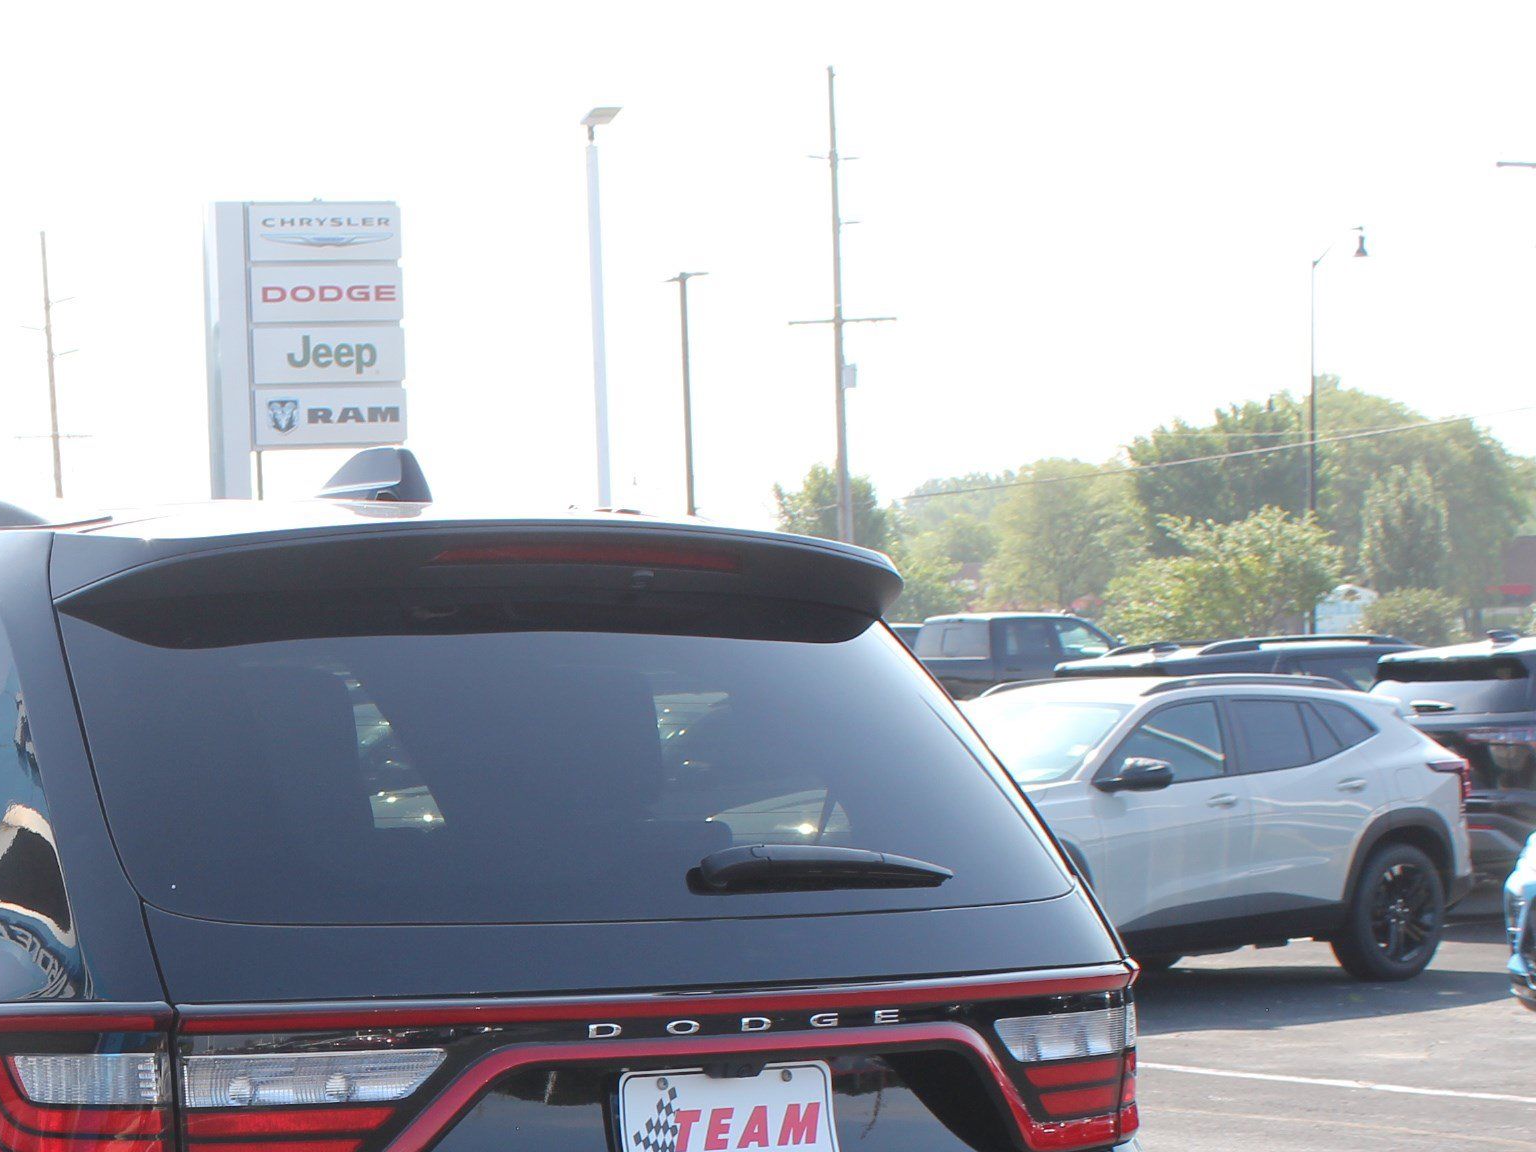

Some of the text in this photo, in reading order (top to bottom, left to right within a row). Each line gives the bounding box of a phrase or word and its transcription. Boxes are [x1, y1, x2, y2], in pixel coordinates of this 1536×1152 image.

[261, 217, 391, 228] CHRYSLER
[261, 285, 397, 303] DODGE
[287, 335, 378, 374] Jeep
[307, 406, 401, 424] RAM
[588, 1008, 900, 1039] DODGE
